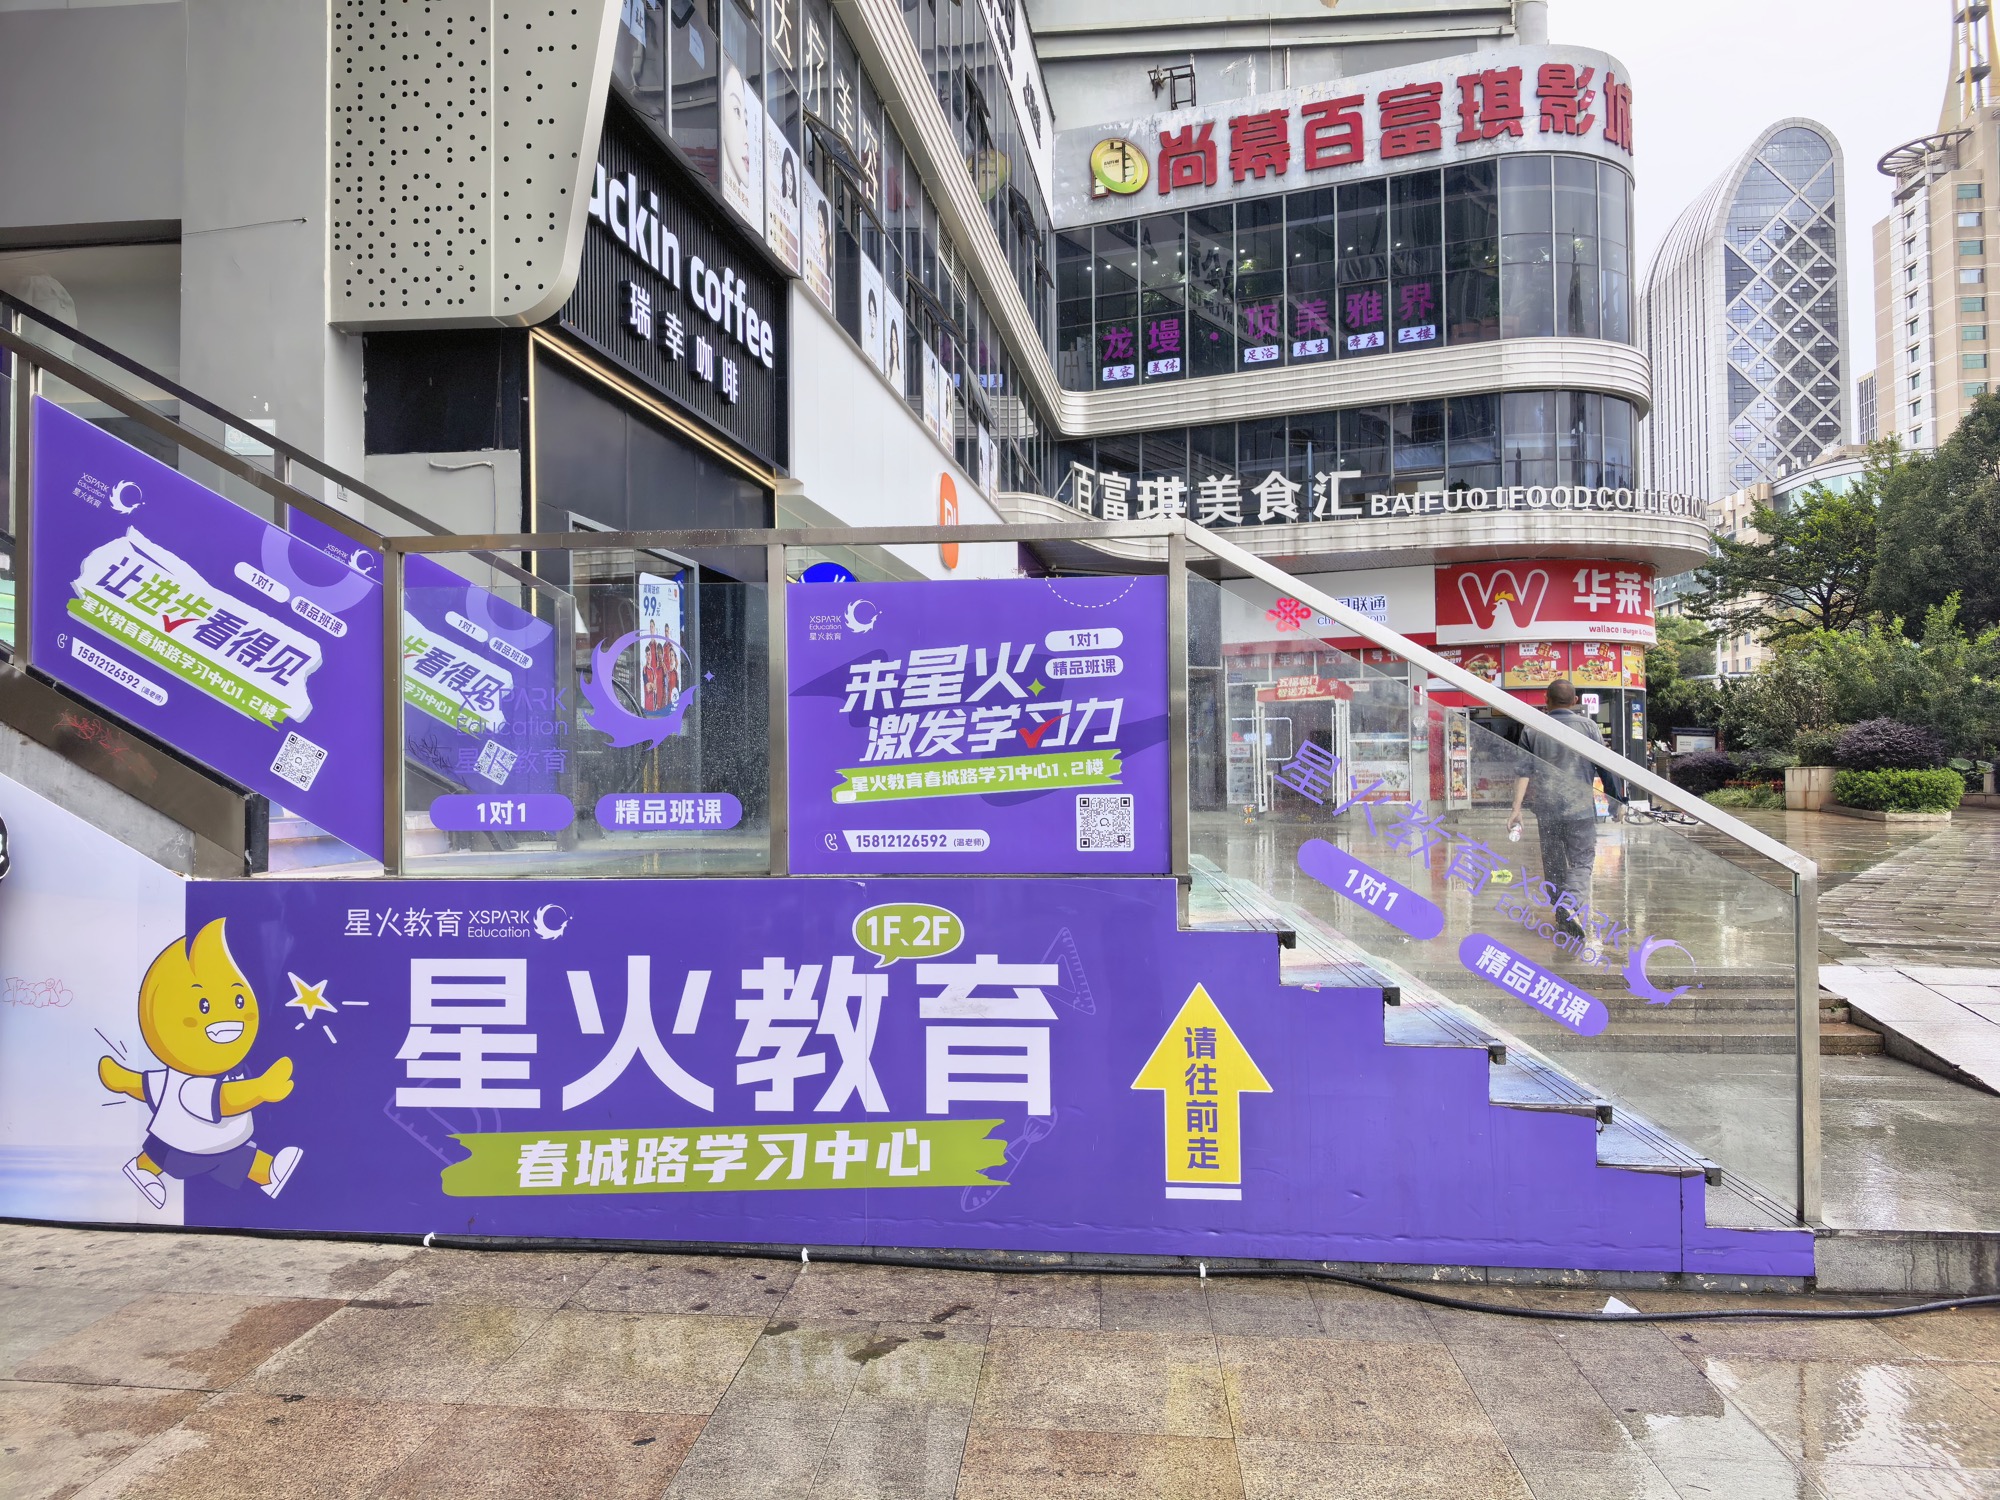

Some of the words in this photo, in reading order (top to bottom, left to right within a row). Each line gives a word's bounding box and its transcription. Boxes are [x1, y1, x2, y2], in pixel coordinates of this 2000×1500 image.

[1158, 63, 1634, 195] 尚幕百富琪影城
[689, 255, 774, 369] coffee
[630, 281, 739, 404] 瑞幸咖啡
[78, 479, 106, 499] Education
[81, 472, 110, 493] XSPARK
[1070, 460, 1362, 525] 百富琪美食汇
[72, 488, 103, 509] 星火教育
[250, 571, 275, 593] 1对1
[96, 556, 311, 687] 让进步看得见
[294, 598, 344, 635] 精品班课
[457, 619, 476, 635] 1对1
[809, 615, 842, 624] XSPARK
[809, 623, 842, 631] Education
[1588, 624, 1620, 634] wallace
[809, 632, 842, 641] 星火教育
[1067, 632, 1100, 648] 1对1
[77, 644, 141, 690] 15812126592
[493, 639, 530, 667] 精品班课
[1052, 657, 1117, 677] 精品班课
[839, 642, 1036, 713] 来星火
[459, 687, 567, 712] XSPARK
[456, 715, 569, 737] Education
[859, 697, 1124, 763] 激发学习力
[455, 746, 569, 774] 星火教育
[476, 799, 527, 826] 1对1
[614, 798, 723, 825] 精品班课
[1274, 738, 1509, 897] 星火教育
[855, 833, 948, 849] 15812126592
[1342, 868, 1399, 912] 1对1
[468, 909, 530, 925] XSPARK
[1510, 865, 1631, 950] XSPARK
[344, 907, 463, 938] 星火教育
[467, 925, 531, 939] Education
[1494, 893, 1611, 974] Education
[1475, 944, 1591, 1027] 精品班课
[395, 954, 1060, 1116] 星火教育
[1183, 1026, 1221, 1171] 请往前走
[516, 1128, 932, 1189] 春城路学习中心
